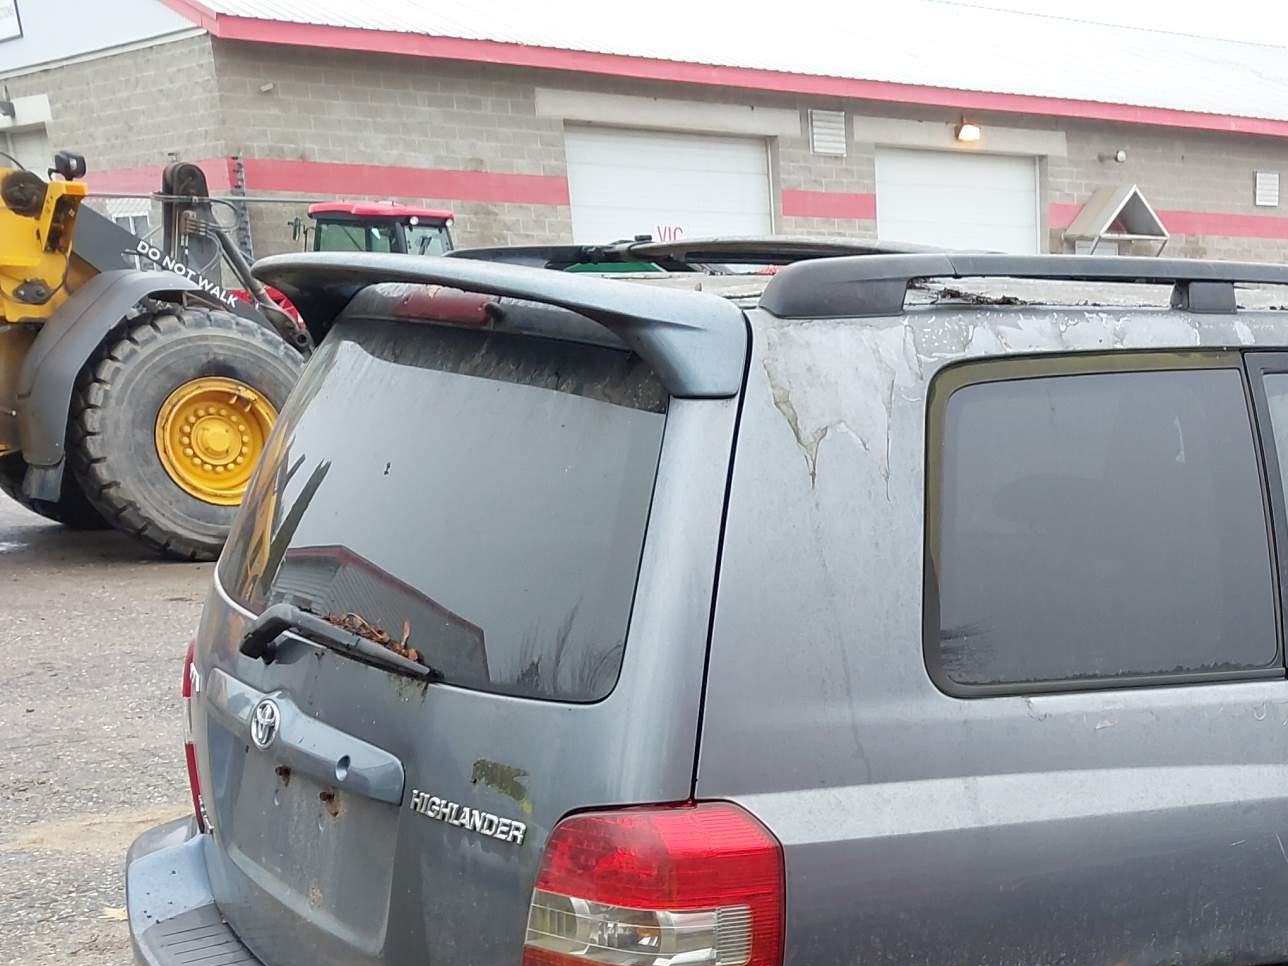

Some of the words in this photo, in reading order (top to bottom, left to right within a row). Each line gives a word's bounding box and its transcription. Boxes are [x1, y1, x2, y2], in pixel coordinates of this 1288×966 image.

[137, 240, 161, 261] DO
[162, 255, 196, 280] NOT
[198, 275, 238, 308] WALK
[410, 789, 527, 844] HIGHLANDER
